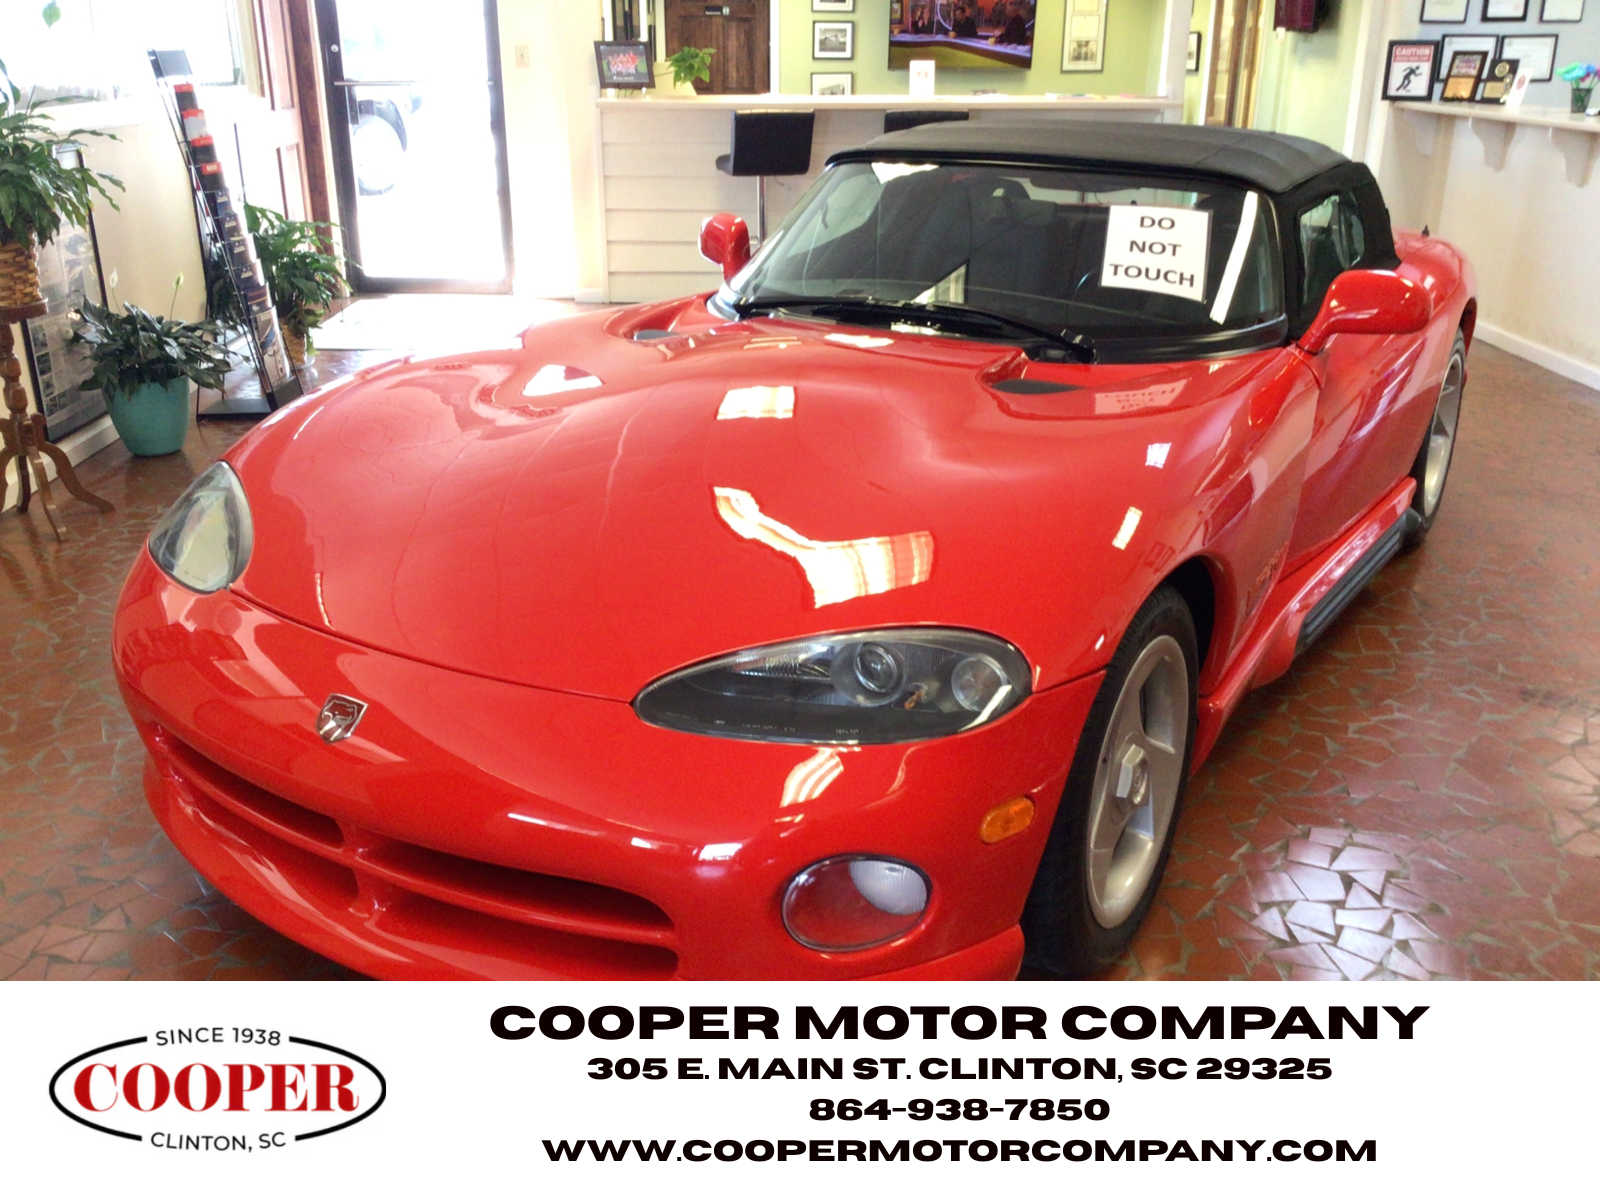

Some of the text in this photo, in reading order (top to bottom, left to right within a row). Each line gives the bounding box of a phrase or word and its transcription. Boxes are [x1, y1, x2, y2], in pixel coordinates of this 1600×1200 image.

[1396, 47, 1430, 56] CAUTION
[1139, 215, 1176, 231] DO
[1128, 239, 1182, 257] NOT
[1109, 263, 1195, 288] TOUCH
